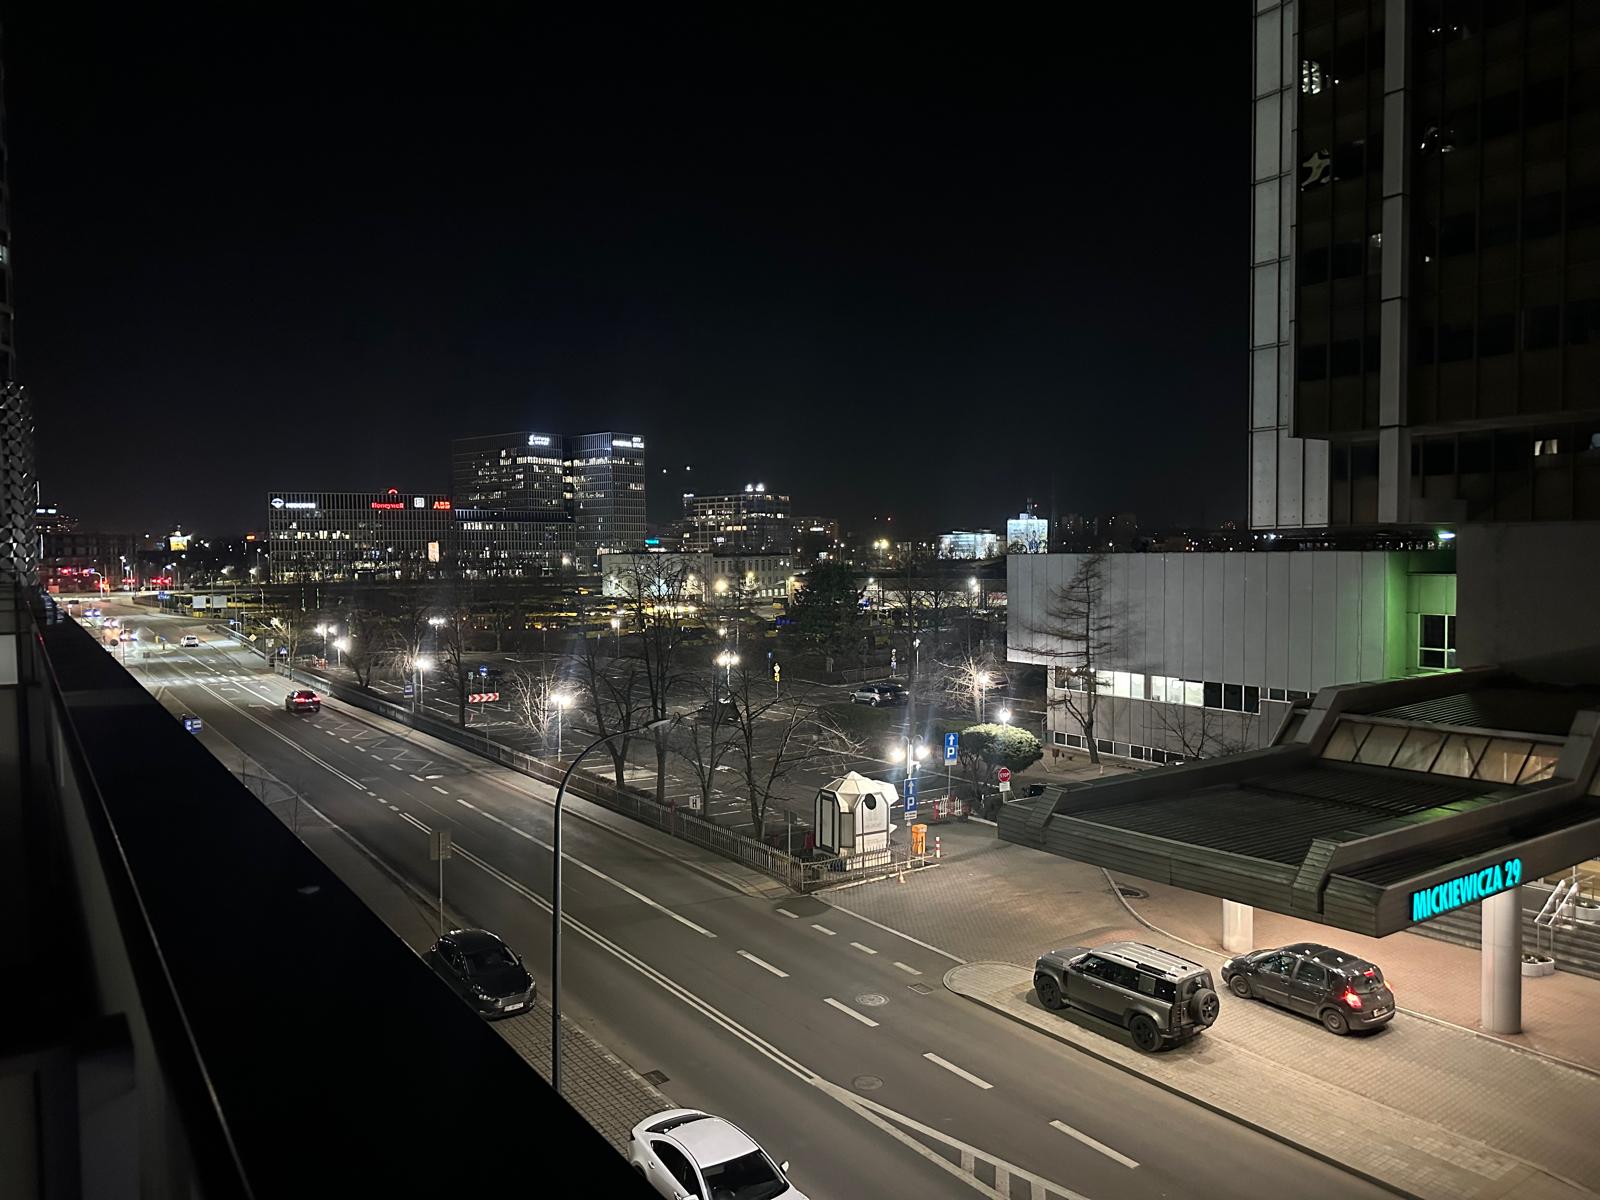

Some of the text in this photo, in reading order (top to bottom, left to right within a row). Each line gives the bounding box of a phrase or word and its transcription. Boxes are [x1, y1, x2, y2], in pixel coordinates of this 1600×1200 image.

[947, 747, 955, 758] P
[907, 798, 915, 810] P
[1414, 858, 1521, 921] MICKIEWICZA 29
